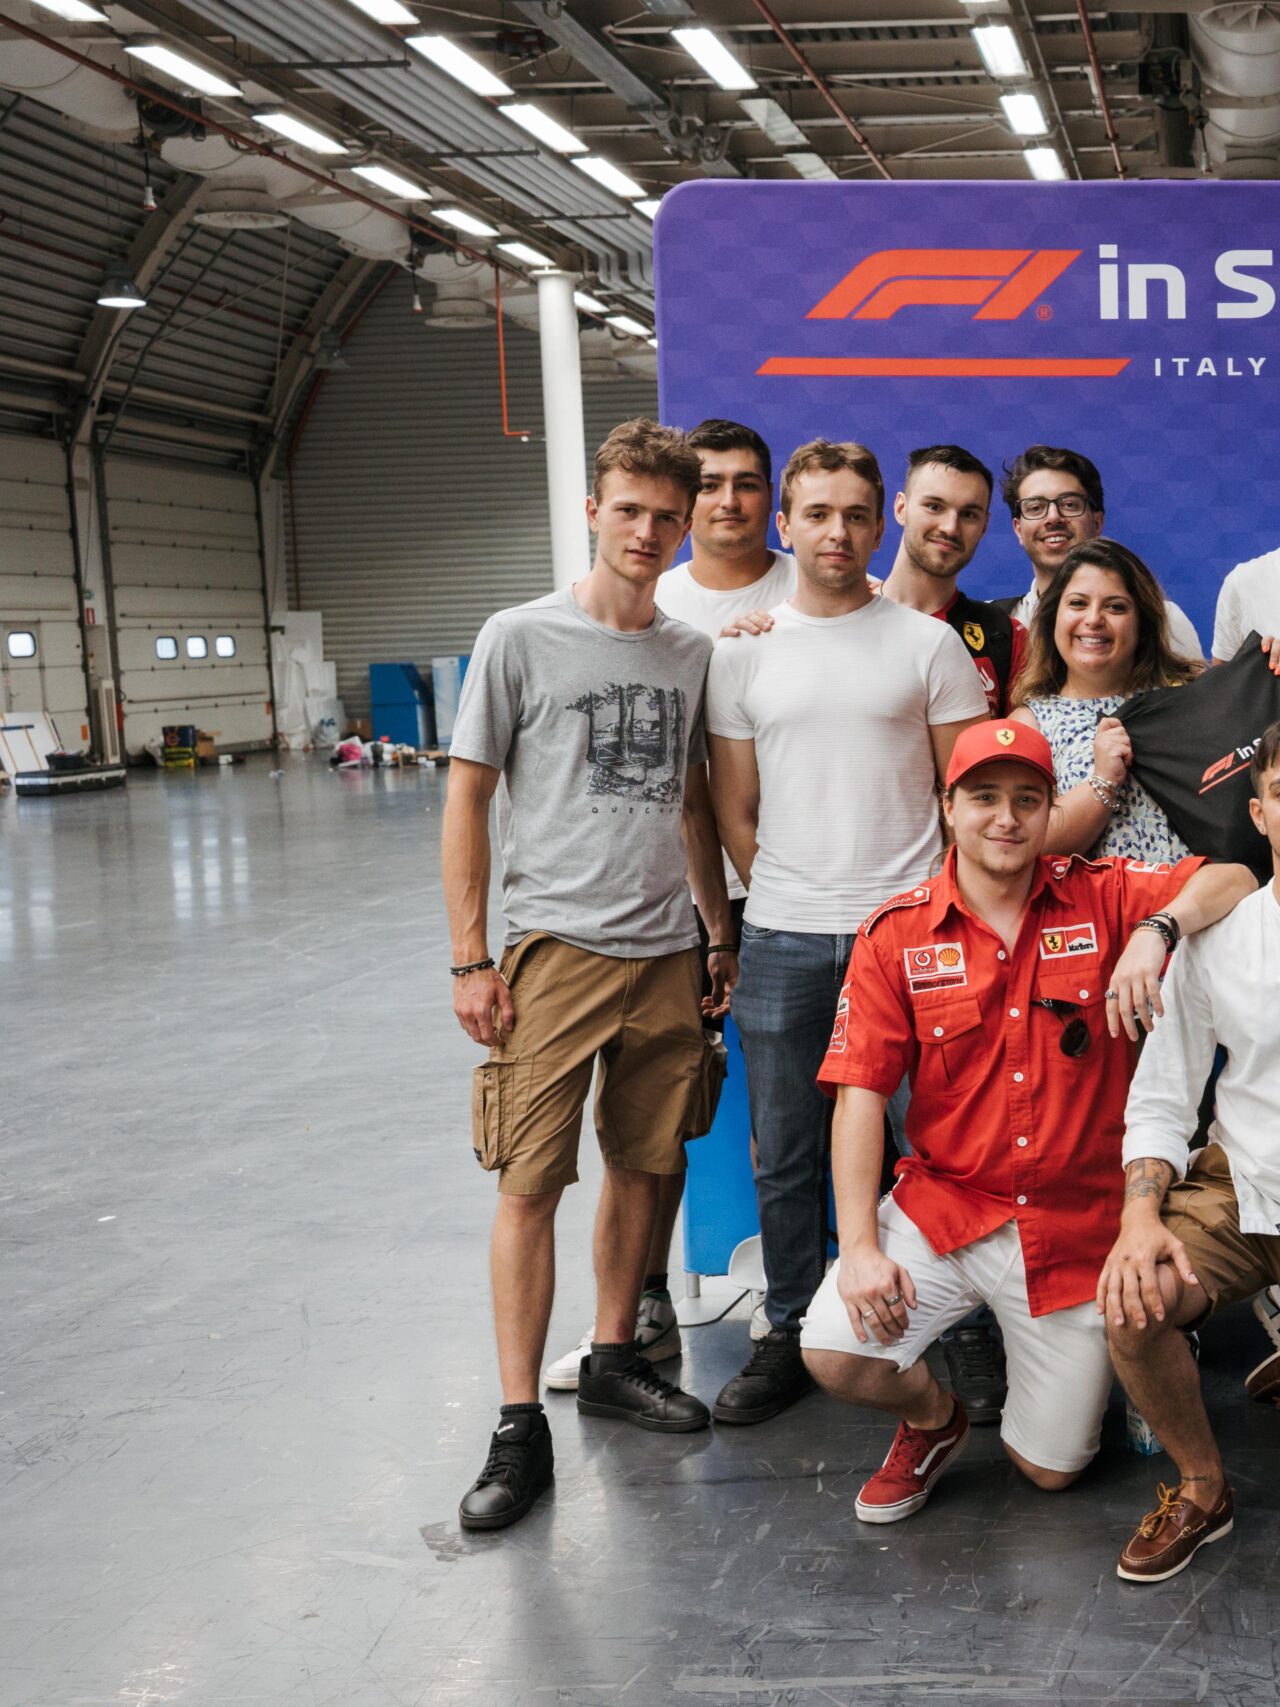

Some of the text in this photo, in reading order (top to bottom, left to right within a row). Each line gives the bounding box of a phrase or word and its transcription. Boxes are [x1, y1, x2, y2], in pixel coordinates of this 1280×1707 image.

[806, 249, 1082, 320] F1
[1099, 244, 1186, 319] in
[1154, 357, 1267, 377] ITALY
[1236, 747, 1255, 760] in
